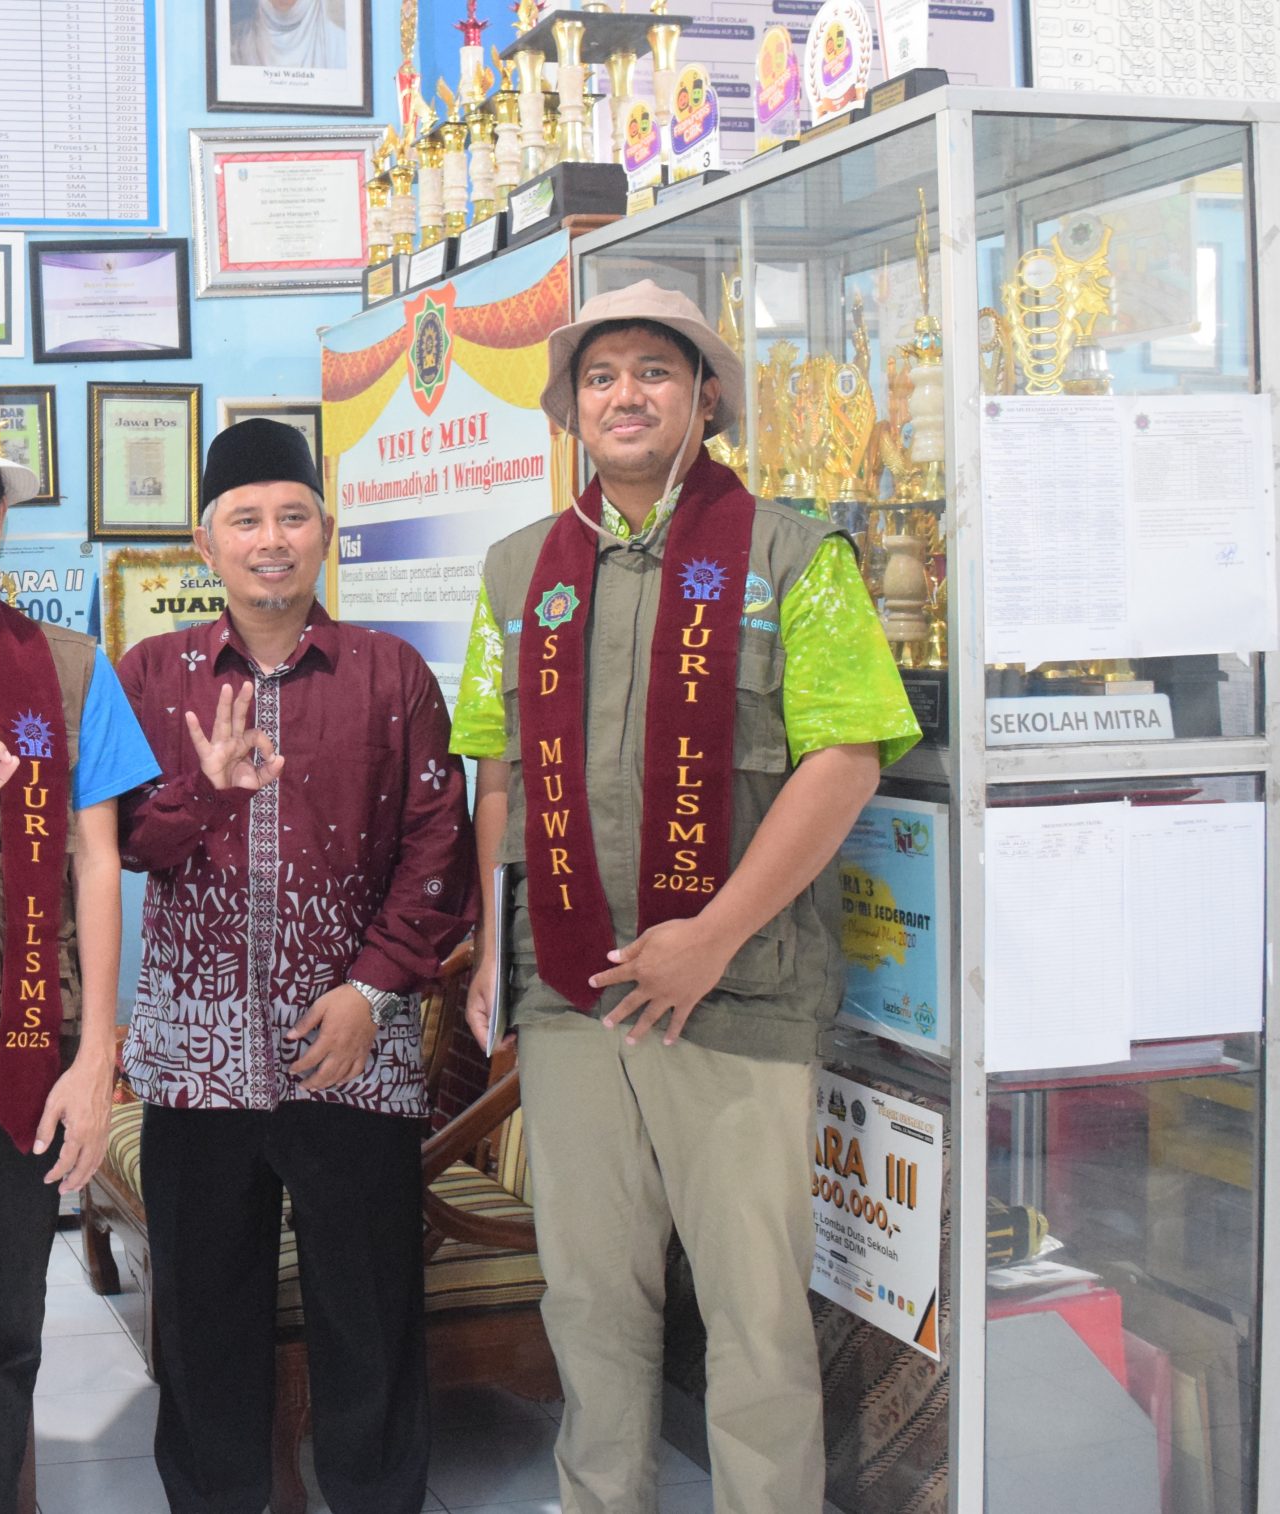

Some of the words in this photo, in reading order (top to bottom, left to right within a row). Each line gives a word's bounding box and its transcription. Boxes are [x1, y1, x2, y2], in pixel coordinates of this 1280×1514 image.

[703, 151, 711, 168] 3
[114, 417, 149, 428] Jawa
[154, 418, 177, 428] Pos
[378, 430, 415, 462] VISI
[439, 411, 490, 452] MISI
[342, 483, 355, 509] SD
[357, 471, 438, 508] Muhammadiyah
[442, 466, 450, 491] 1
[454, 454, 544, 493] Wringinanom
[340, 534, 362, 558] Visi
[390, 566, 408, 580] Islam
[409, 564, 440, 583] pencetak
[443, 562, 475, 581] generasi
[401, 587, 422, 606] peduli
[424, 587, 437, 602] dan
[678, 604, 712, 703] JURI
[990, 708, 1088, 734] SEKOLAH
[1094, 708, 1162, 731] MITRA
[24, 760, 49, 863] JURI
[667, 737, 706, 871] LLSMS
[653, 873, 715, 893] 2025
[866, 878, 875, 897] 3
[19, 896, 46, 1029] LLSMS
[6, 1031, 50, 1048] 2025
[885, 1152, 918, 1211] III
[815, 1222, 842, 1245] Tingkat
[844, 1238, 866, 1258] SD/MI
[820, 1212, 845, 1234] Lomba
[847, 1226, 865, 1244] Duta
[867, 1237, 898, 1262] Sekolah
